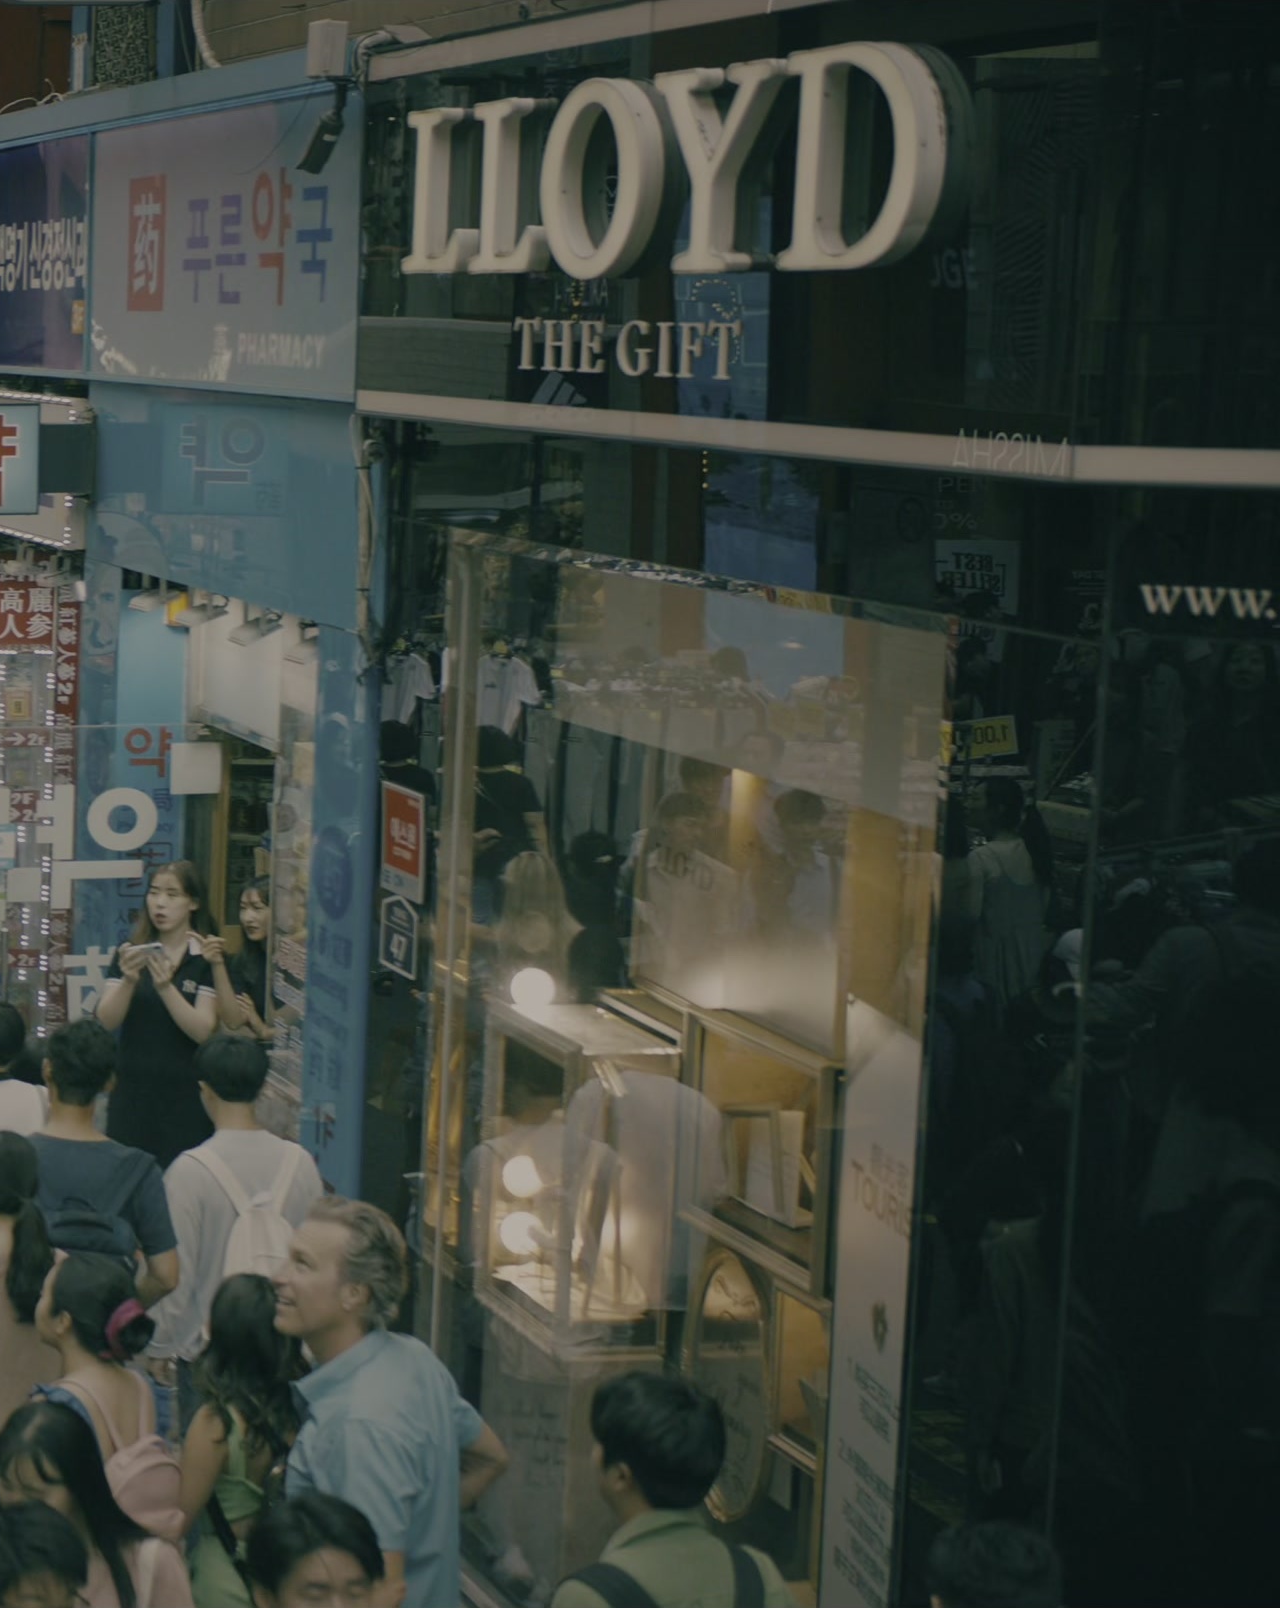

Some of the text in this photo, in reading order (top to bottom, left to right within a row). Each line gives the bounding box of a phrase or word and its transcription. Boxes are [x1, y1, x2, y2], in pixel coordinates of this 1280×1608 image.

[399, 40, 968, 280] LLOYD
[239, 332, 326, 370] PHARMACY
[514, 316, 744, 381] THE GIFT
[1139, 583, 1278, 620] www.
